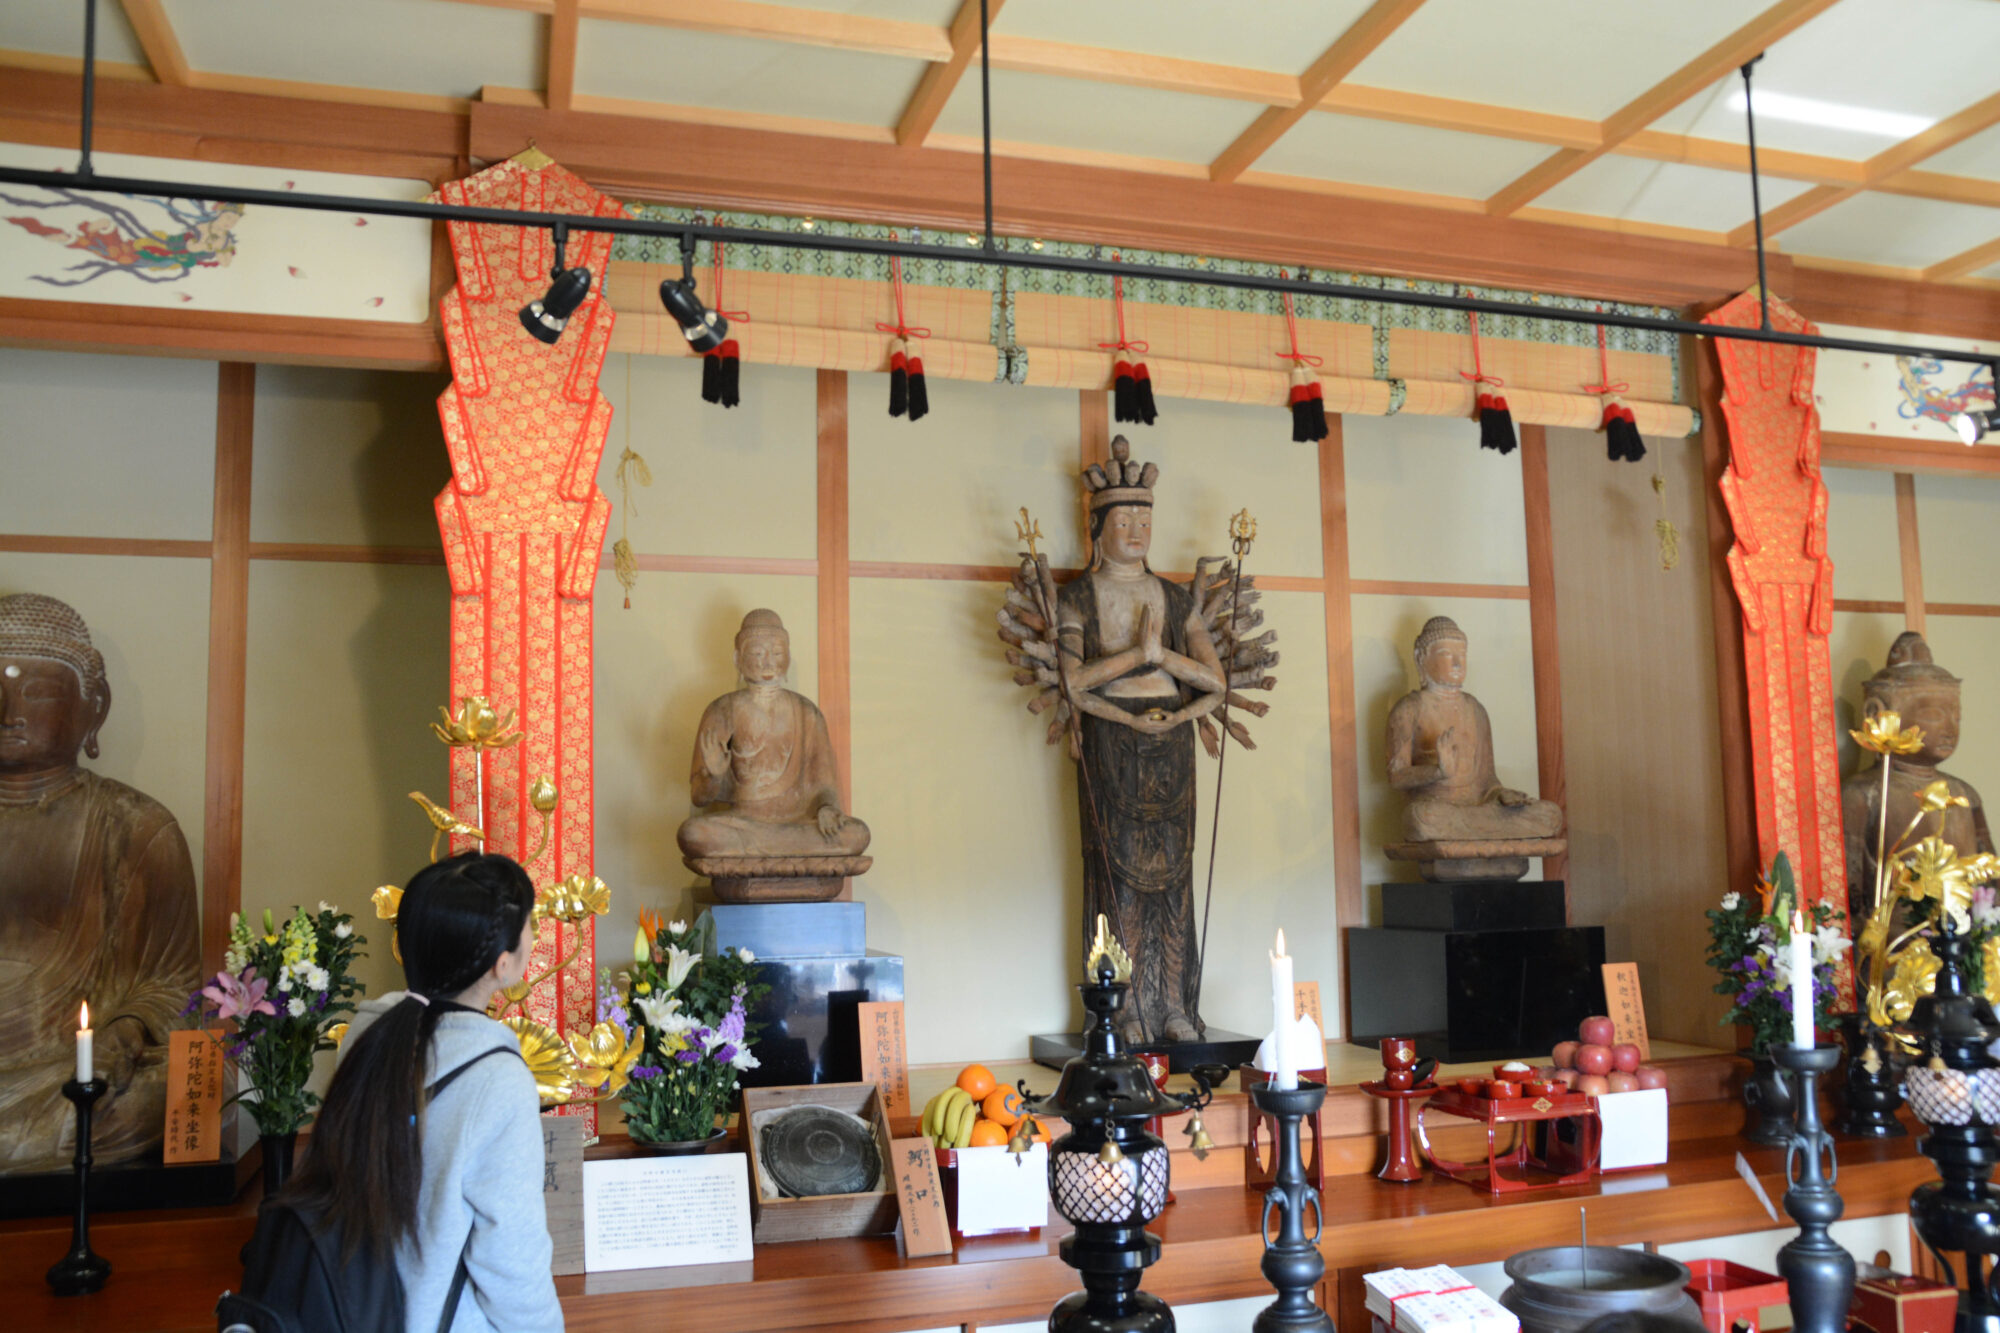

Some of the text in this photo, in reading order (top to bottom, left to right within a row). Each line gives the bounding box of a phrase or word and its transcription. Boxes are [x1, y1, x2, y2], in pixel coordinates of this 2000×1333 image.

[1295, 989, 1307, 1021] 千手
[183, 1040, 205, 1151] 阿弥陀如来坐像
